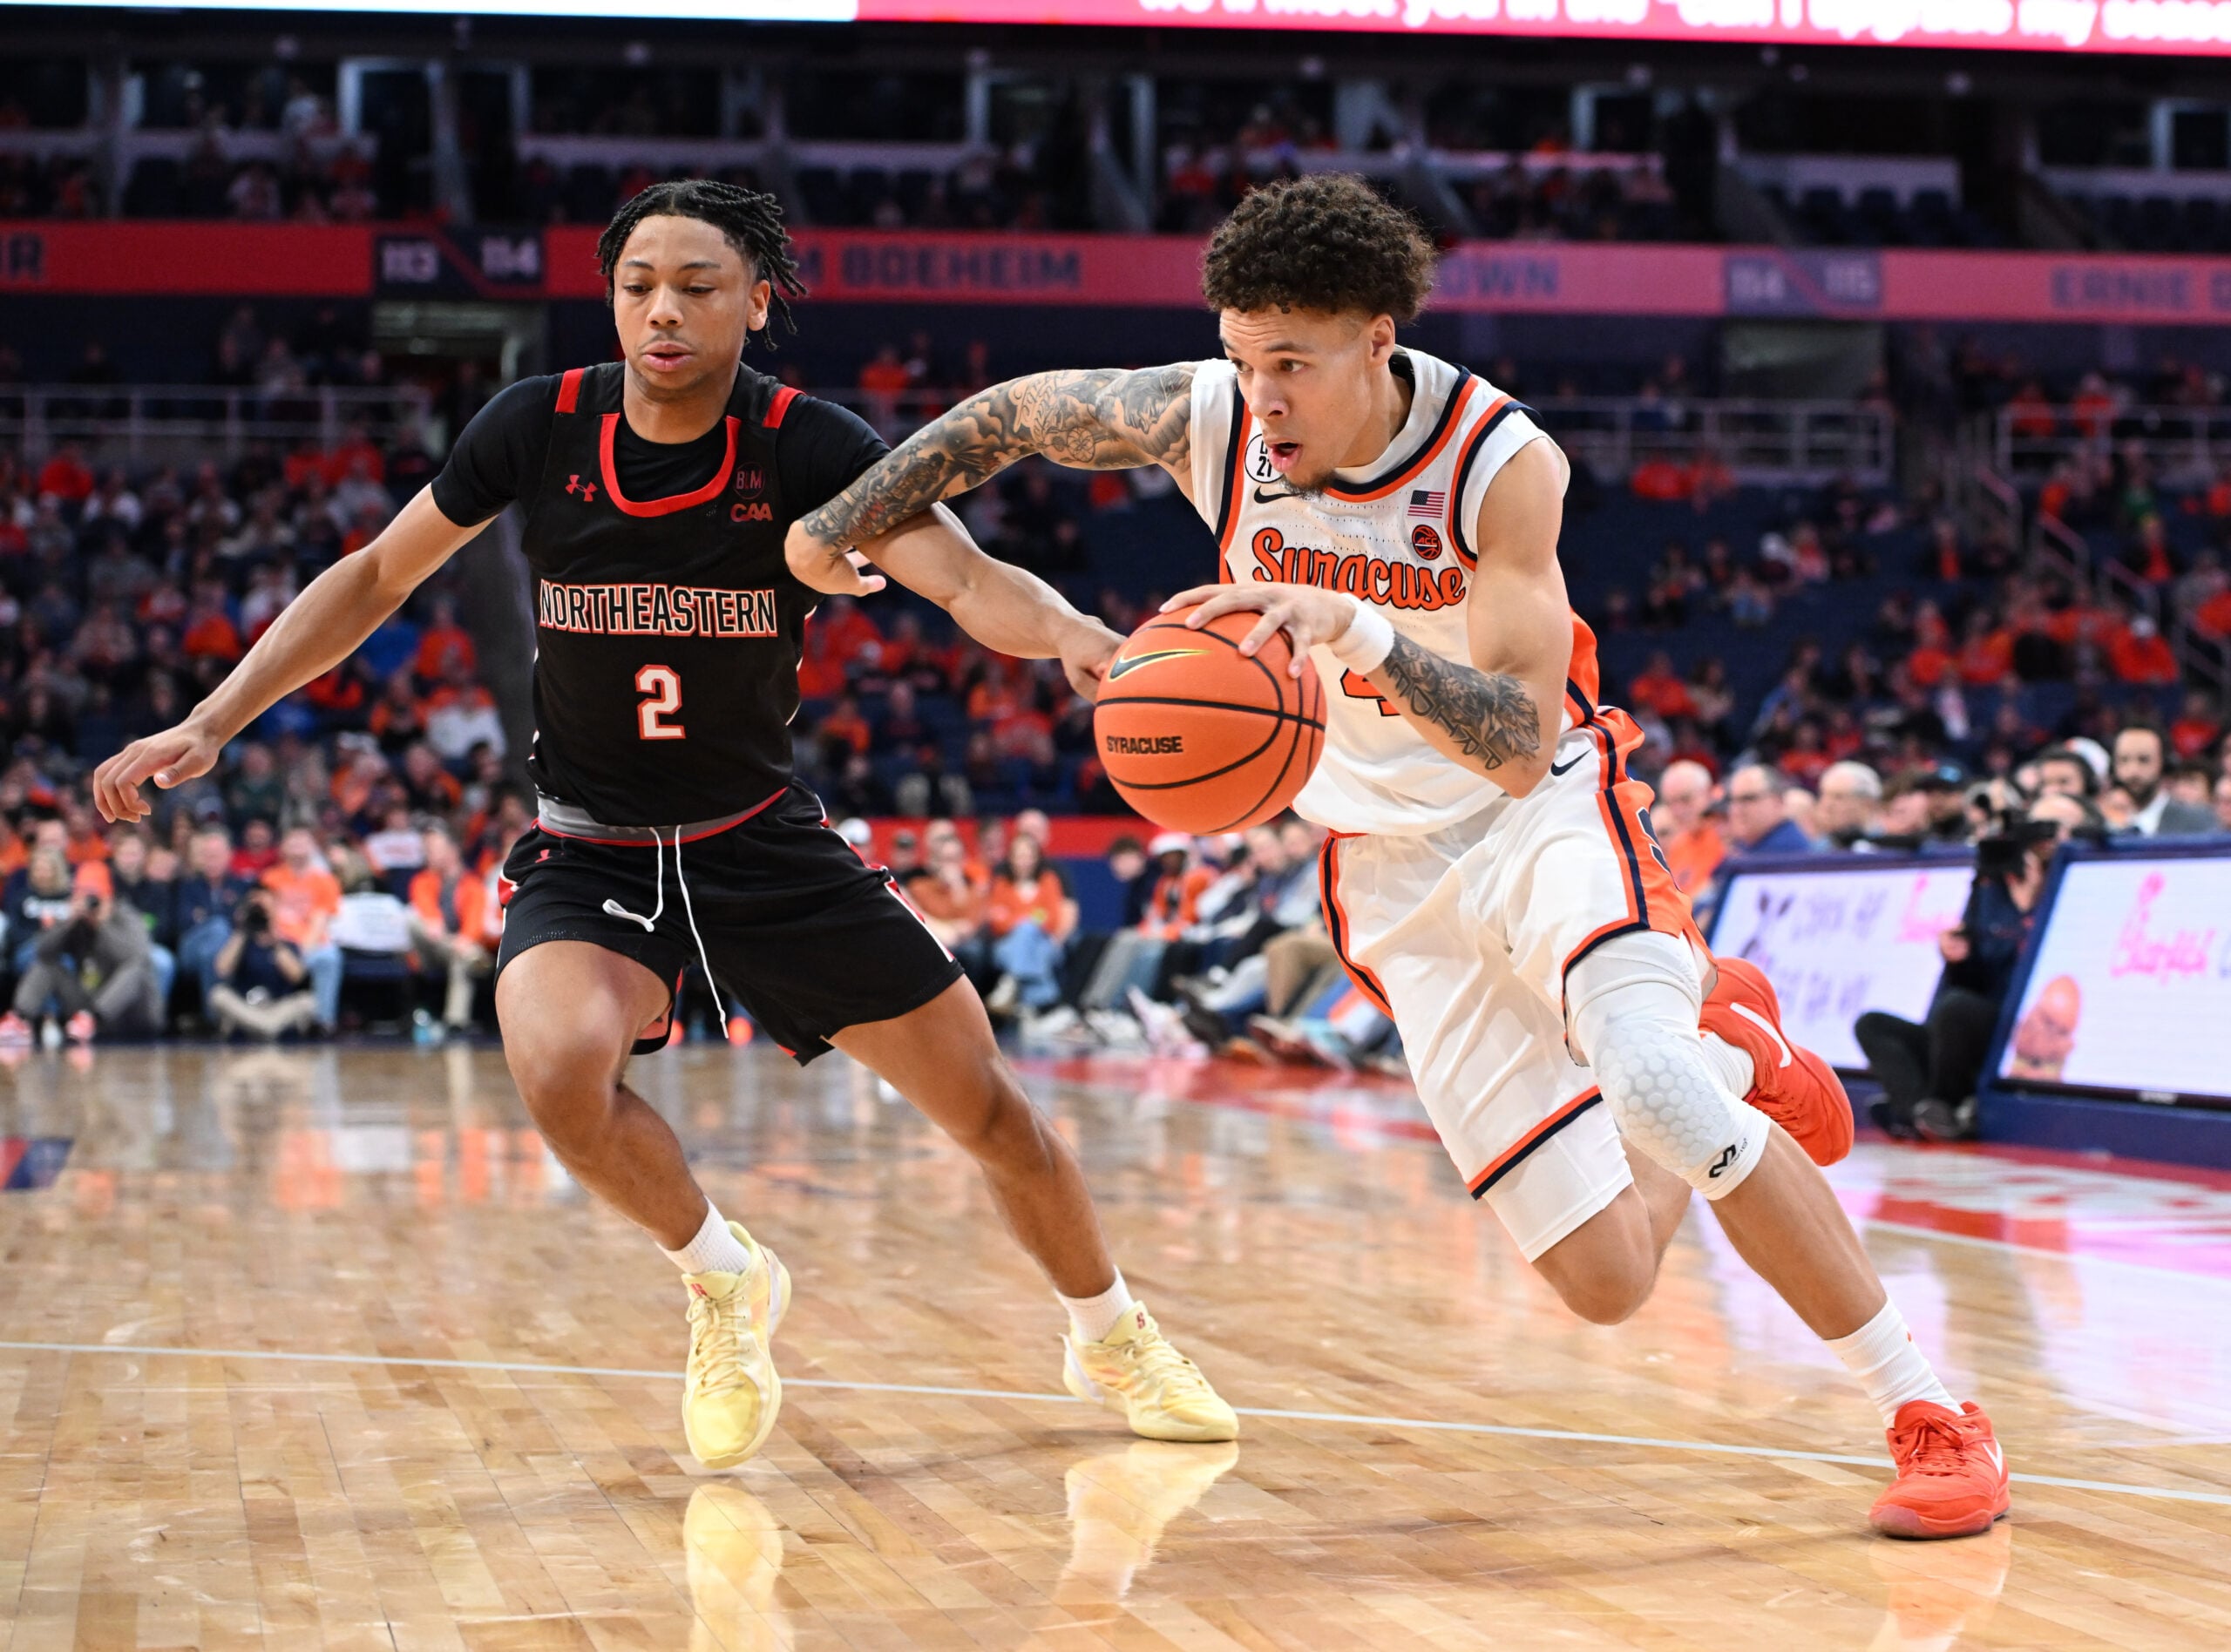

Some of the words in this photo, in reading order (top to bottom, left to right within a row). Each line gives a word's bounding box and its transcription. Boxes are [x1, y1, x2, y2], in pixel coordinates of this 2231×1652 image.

[730, 503, 773, 523] CAA
[539, 579, 778, 638] NORTHEASTERN
[634, 664, 687, 740] 2
[1106, 735, 1183, 755] SYRACUSE
